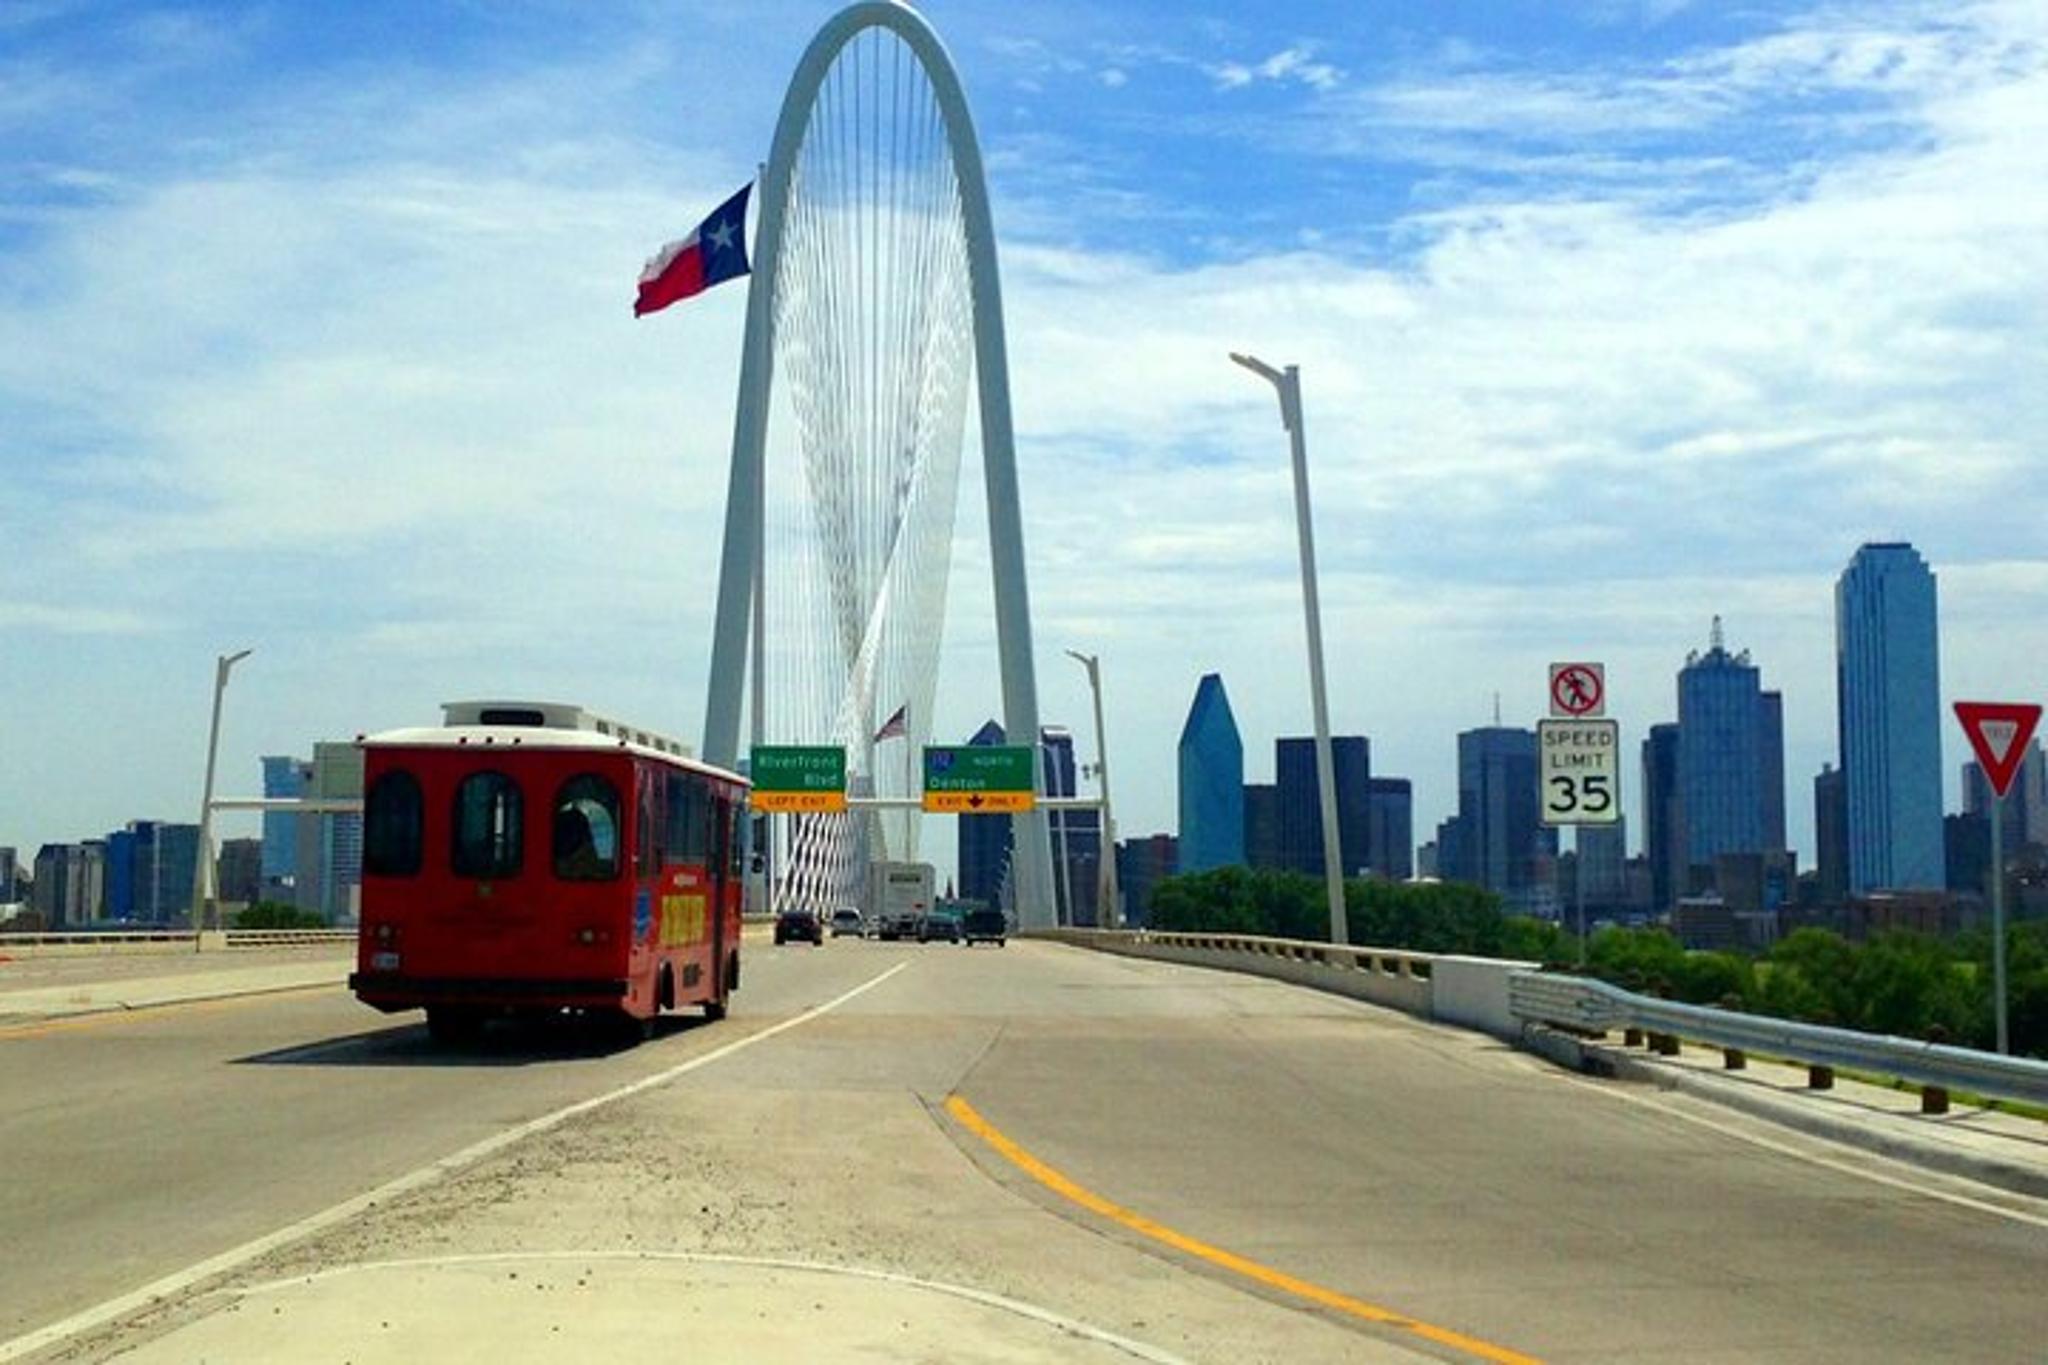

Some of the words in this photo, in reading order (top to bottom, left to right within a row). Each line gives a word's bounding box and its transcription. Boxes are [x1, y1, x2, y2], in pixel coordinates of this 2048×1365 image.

[1545, 730, 1611, 746] SPEED
[759, 755, 837, 768] Riverfront
[1551, 753, 1603, 768] LIMIT
[804, 773, 837, 786] Blvd
[767, 796, 795, 806] LEFT
[1549, 776, 1611, 813] 35
